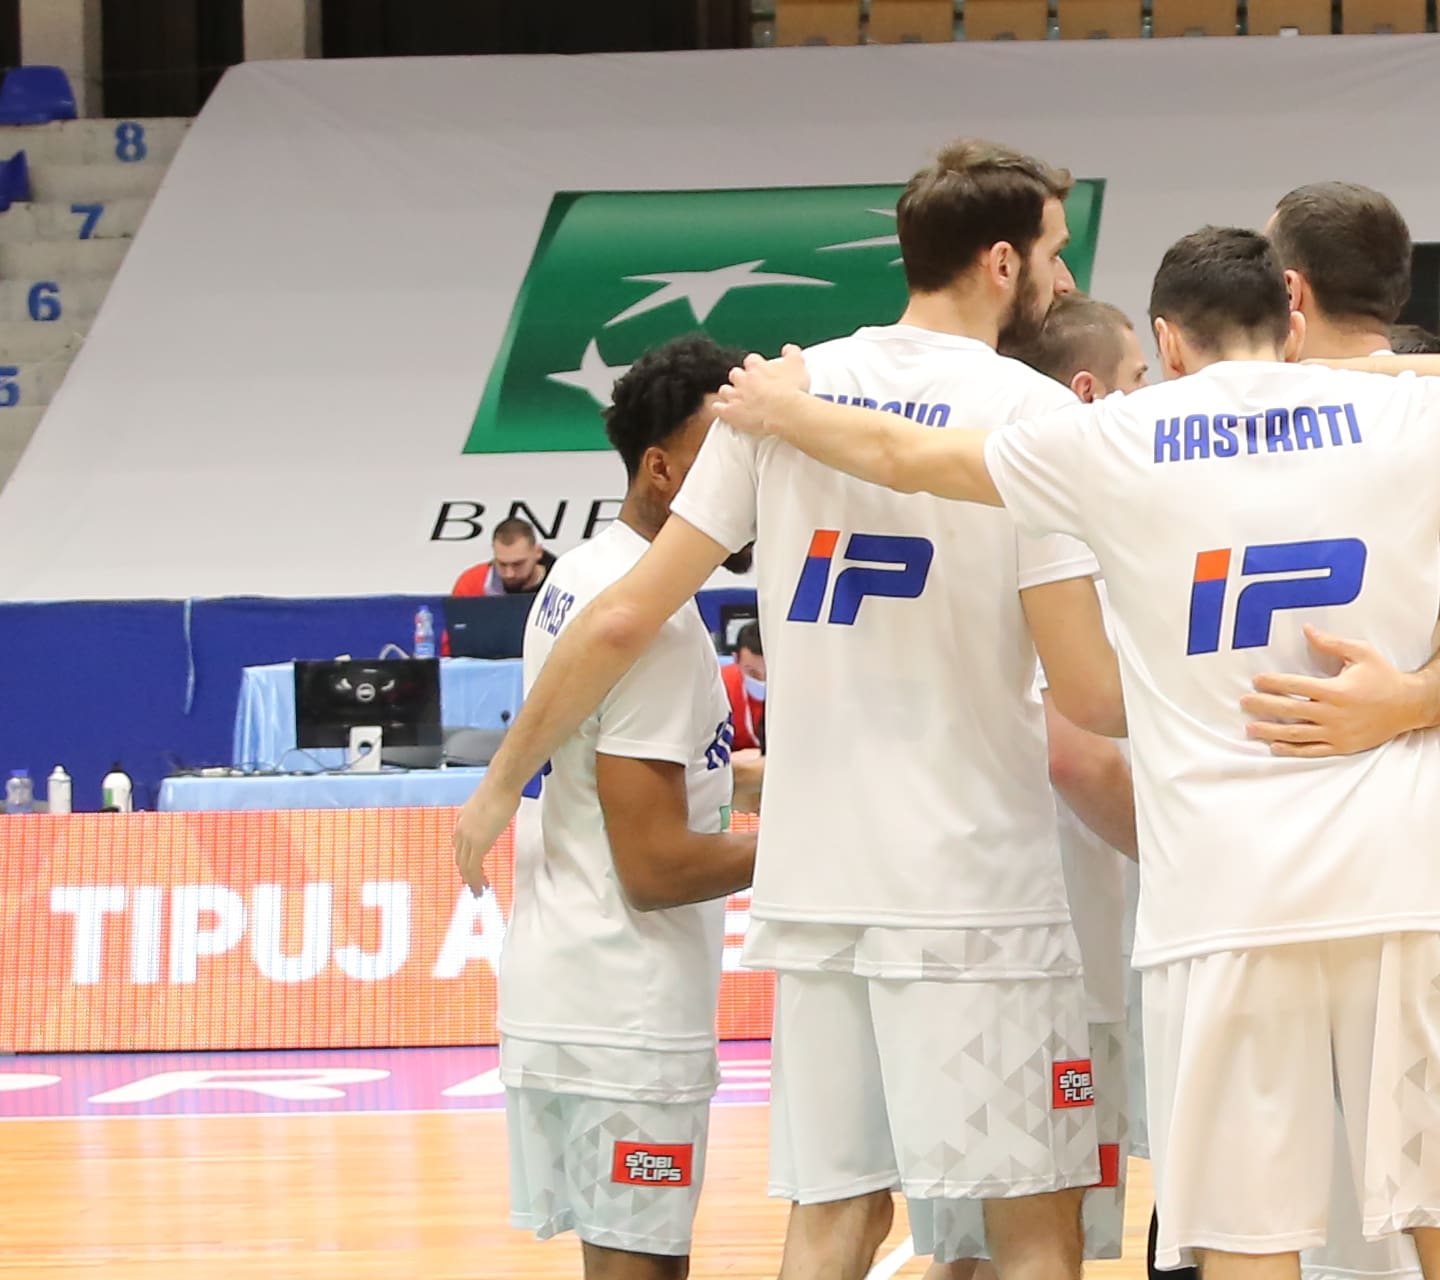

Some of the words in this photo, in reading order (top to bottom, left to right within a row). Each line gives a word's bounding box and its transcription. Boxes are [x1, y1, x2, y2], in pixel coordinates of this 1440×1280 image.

[114, 121, 147, 162] 8
[70, 203, 105, 240] 7
[27, 281, 62, 321] 6
[1153, 402, 1363, 464] KASTRATI
[49, 881, 412, 987] TIPUJ
[431, 884, 509, 980] A
[1060, 1070, 1091, 1089] STOB
[624, 1151, 673, 1169] STOBI
[629, 1168, 682, 1181] FLIPS
